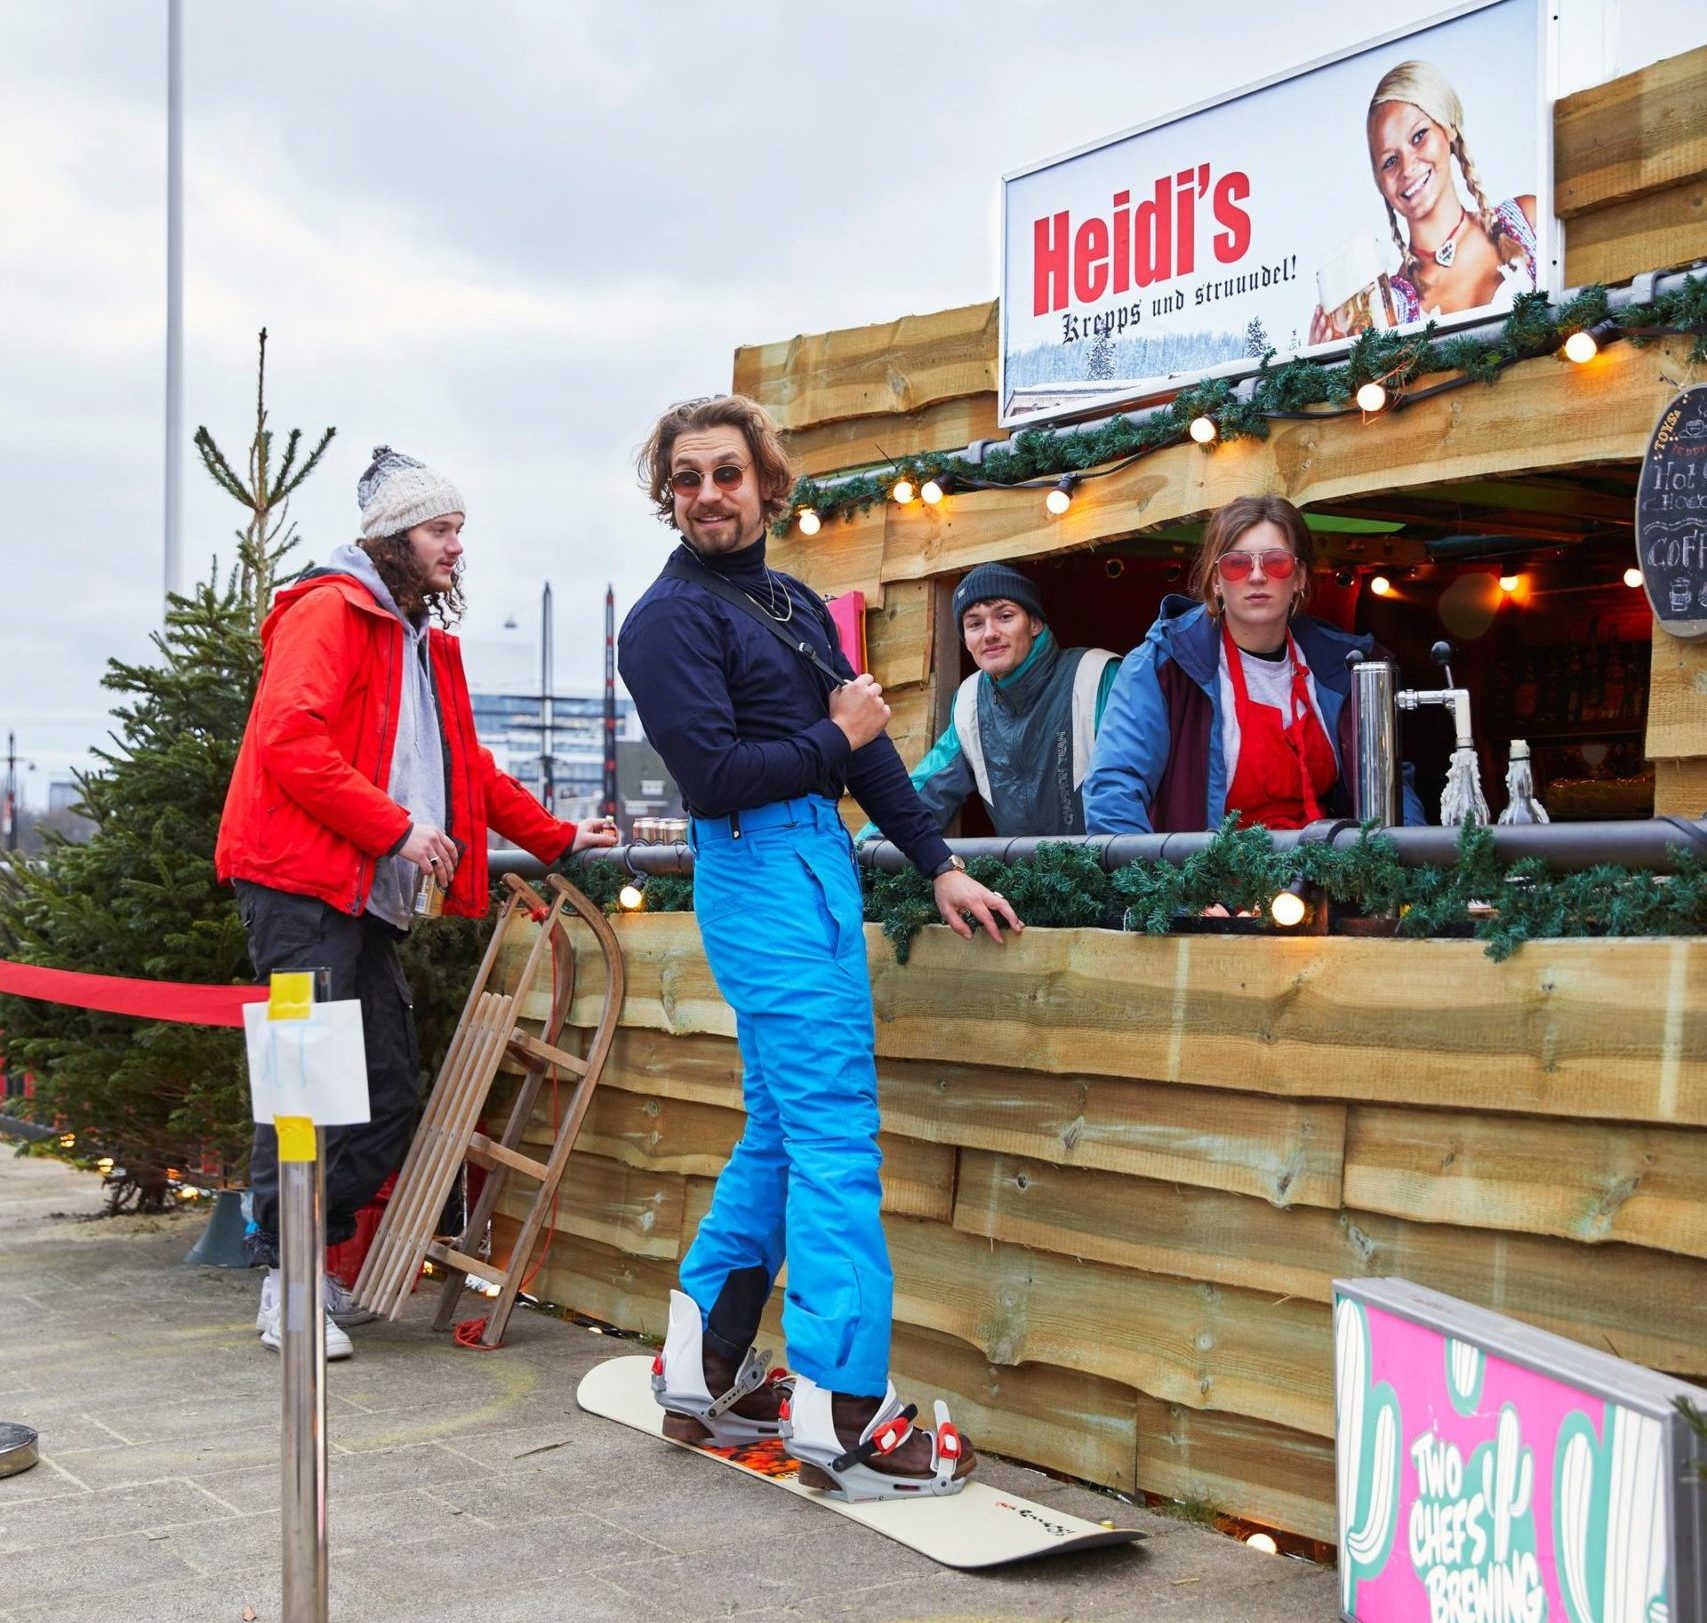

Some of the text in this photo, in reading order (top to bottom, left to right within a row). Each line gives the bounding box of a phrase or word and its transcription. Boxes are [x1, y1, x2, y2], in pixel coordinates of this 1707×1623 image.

[1034, 162, 1251, 317] Heidi's
[1062, 300, 1142, 345] Krepps
[1152, 289, 1184, 317] und
[1653, 461, 1696, 490] Hot
[1410, 1432, 1462, 1499] TWO
[1409, 1492, 1487, 1567] CHEFS
[1425, 1549, 1544, 1623] BREWING
